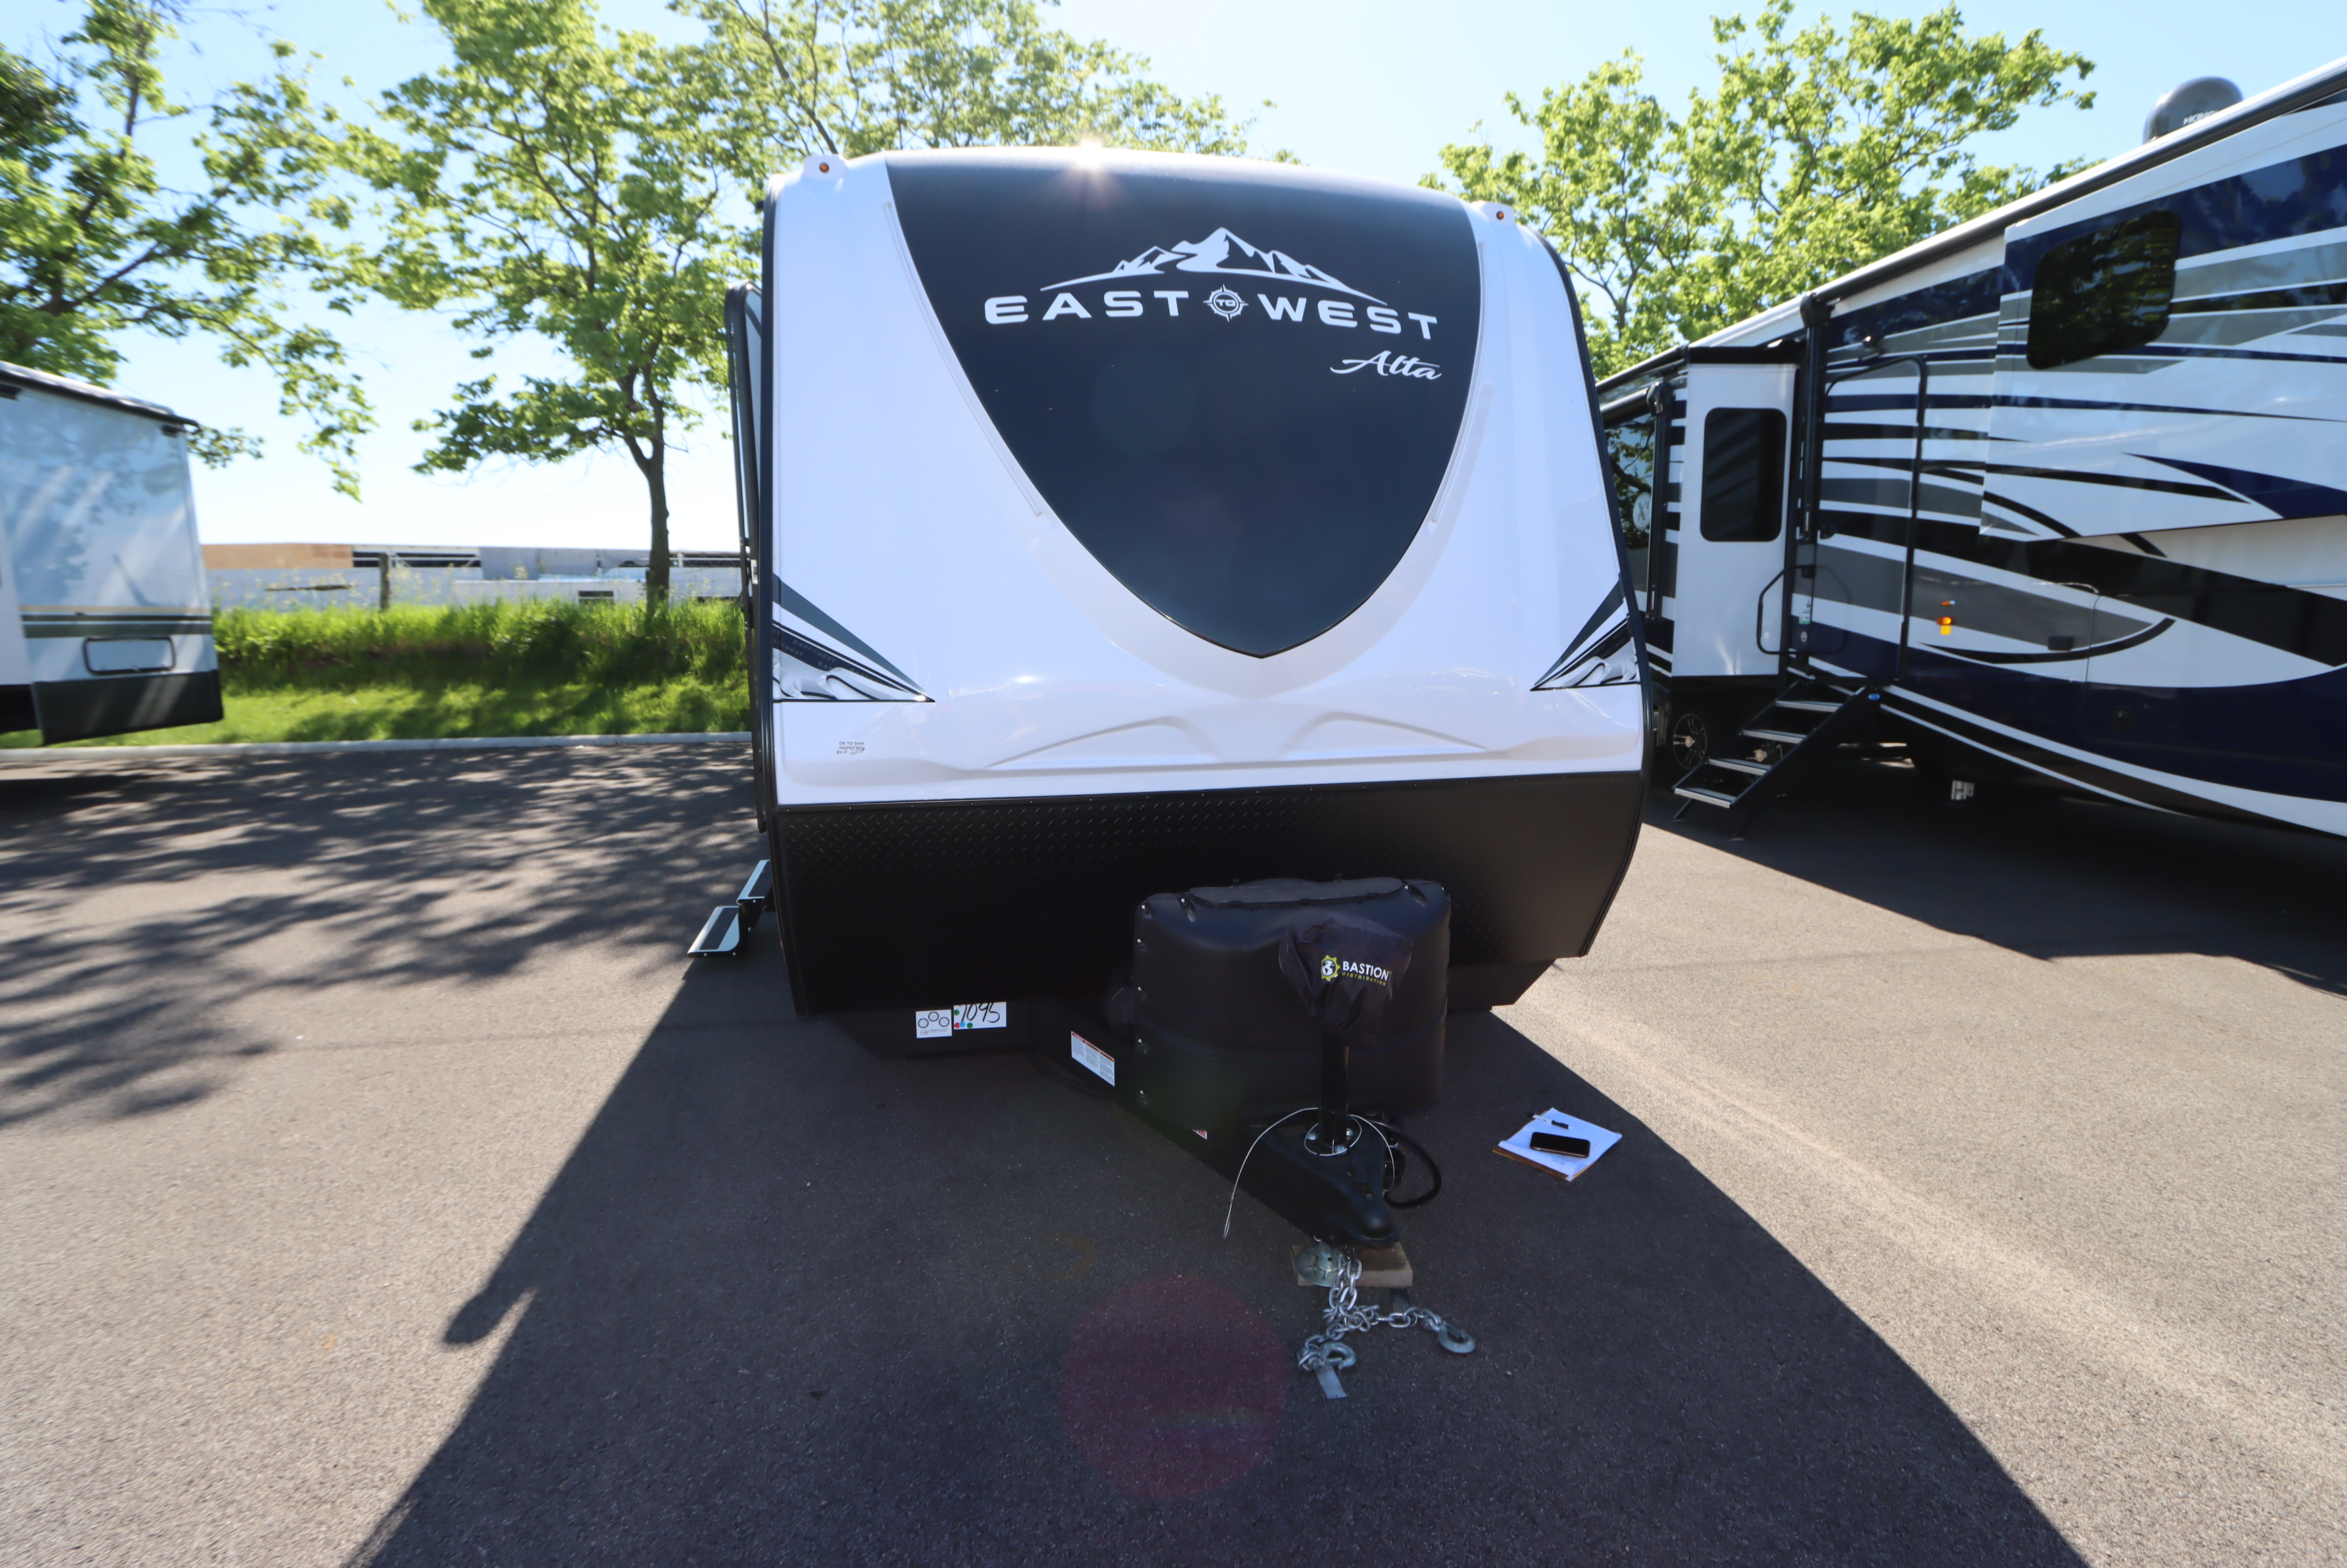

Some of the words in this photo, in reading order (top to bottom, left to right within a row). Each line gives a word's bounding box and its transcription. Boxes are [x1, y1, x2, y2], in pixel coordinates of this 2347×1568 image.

[984, 290, 1189, 324] EAST
[1216, 299, 1236, 307] TO
[1257, 293, 1438, 340] WEST
[1330, 350, 1442, 380] Alta
[816, 651, 836, 663] WEST
[1342, 960, 1389, 981] BASTION
[1342, 972, 1386, 987] DISTRIBUTION
